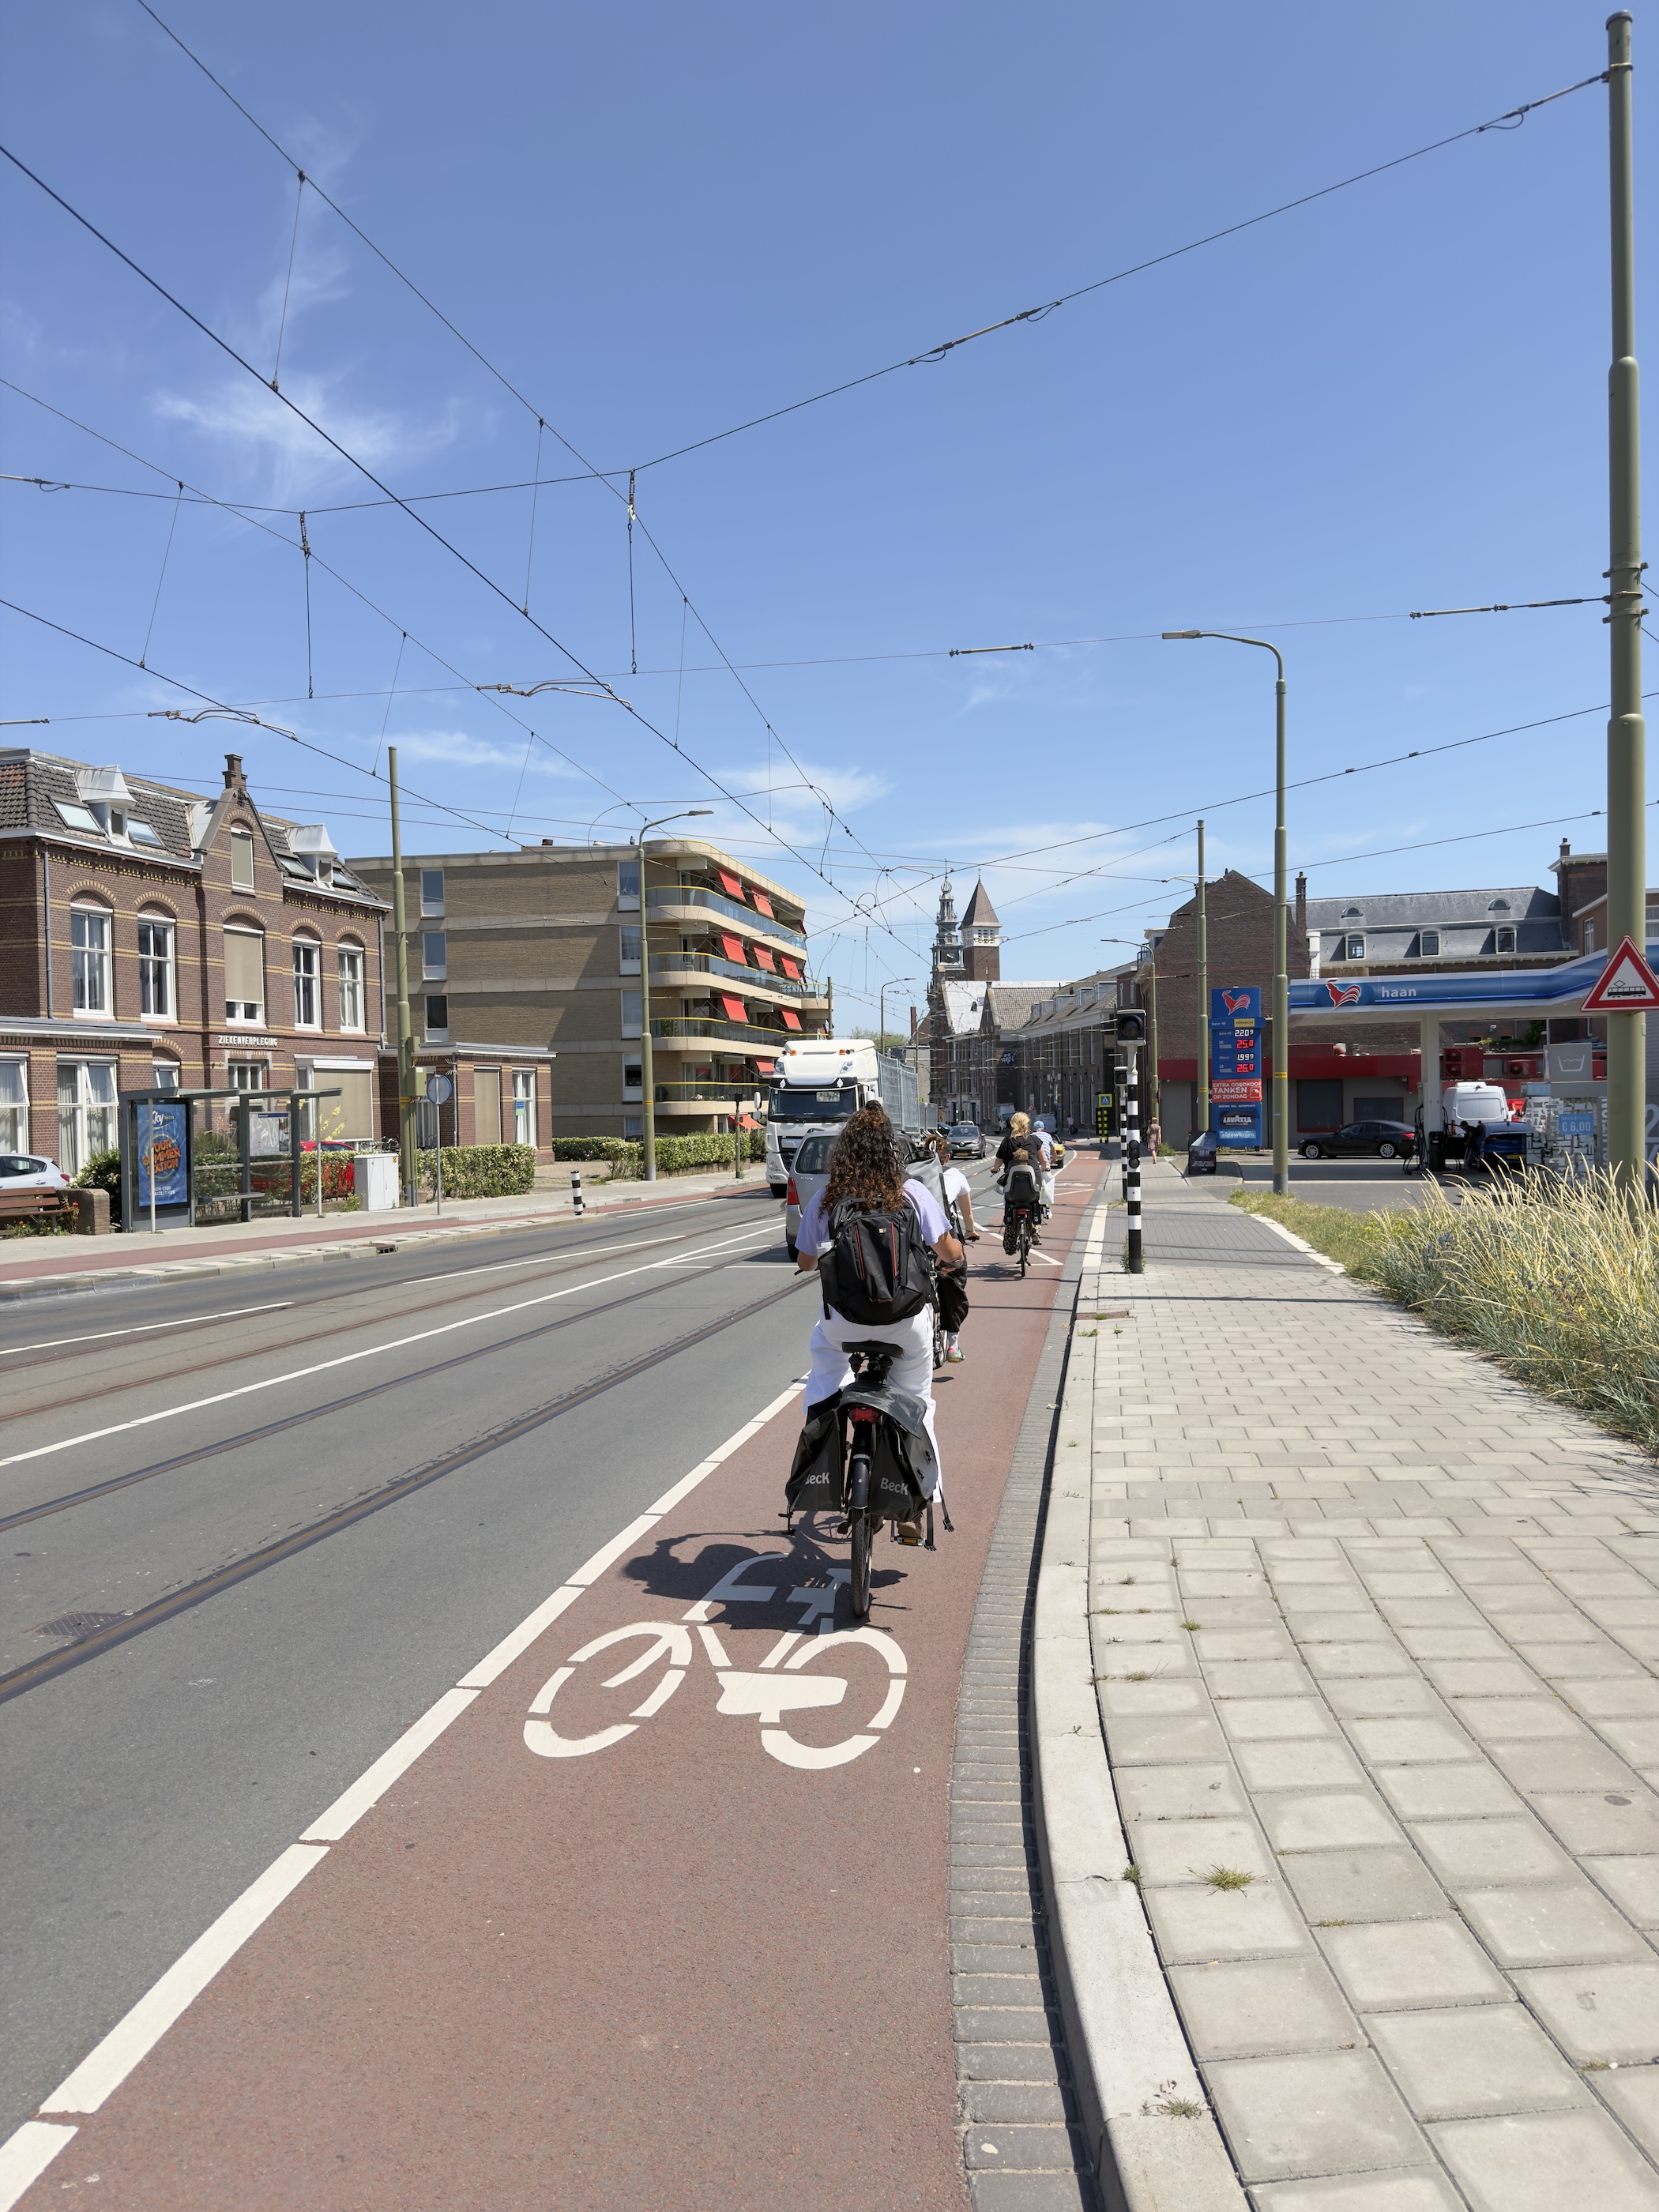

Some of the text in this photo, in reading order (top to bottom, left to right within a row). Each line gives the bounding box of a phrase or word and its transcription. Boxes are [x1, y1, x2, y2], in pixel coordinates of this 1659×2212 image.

[1381, 986, 1416, 998] haan
[218, 1035, 278, 1046] ZIEKENVERPLEGING
[1570, 1121, 1591, 1133] 6,00
[153, 1139, 171, 1153] OUR
[142, 1148, 181, 1166] SMMER
[880, 1477, 908, 1495] Beck
